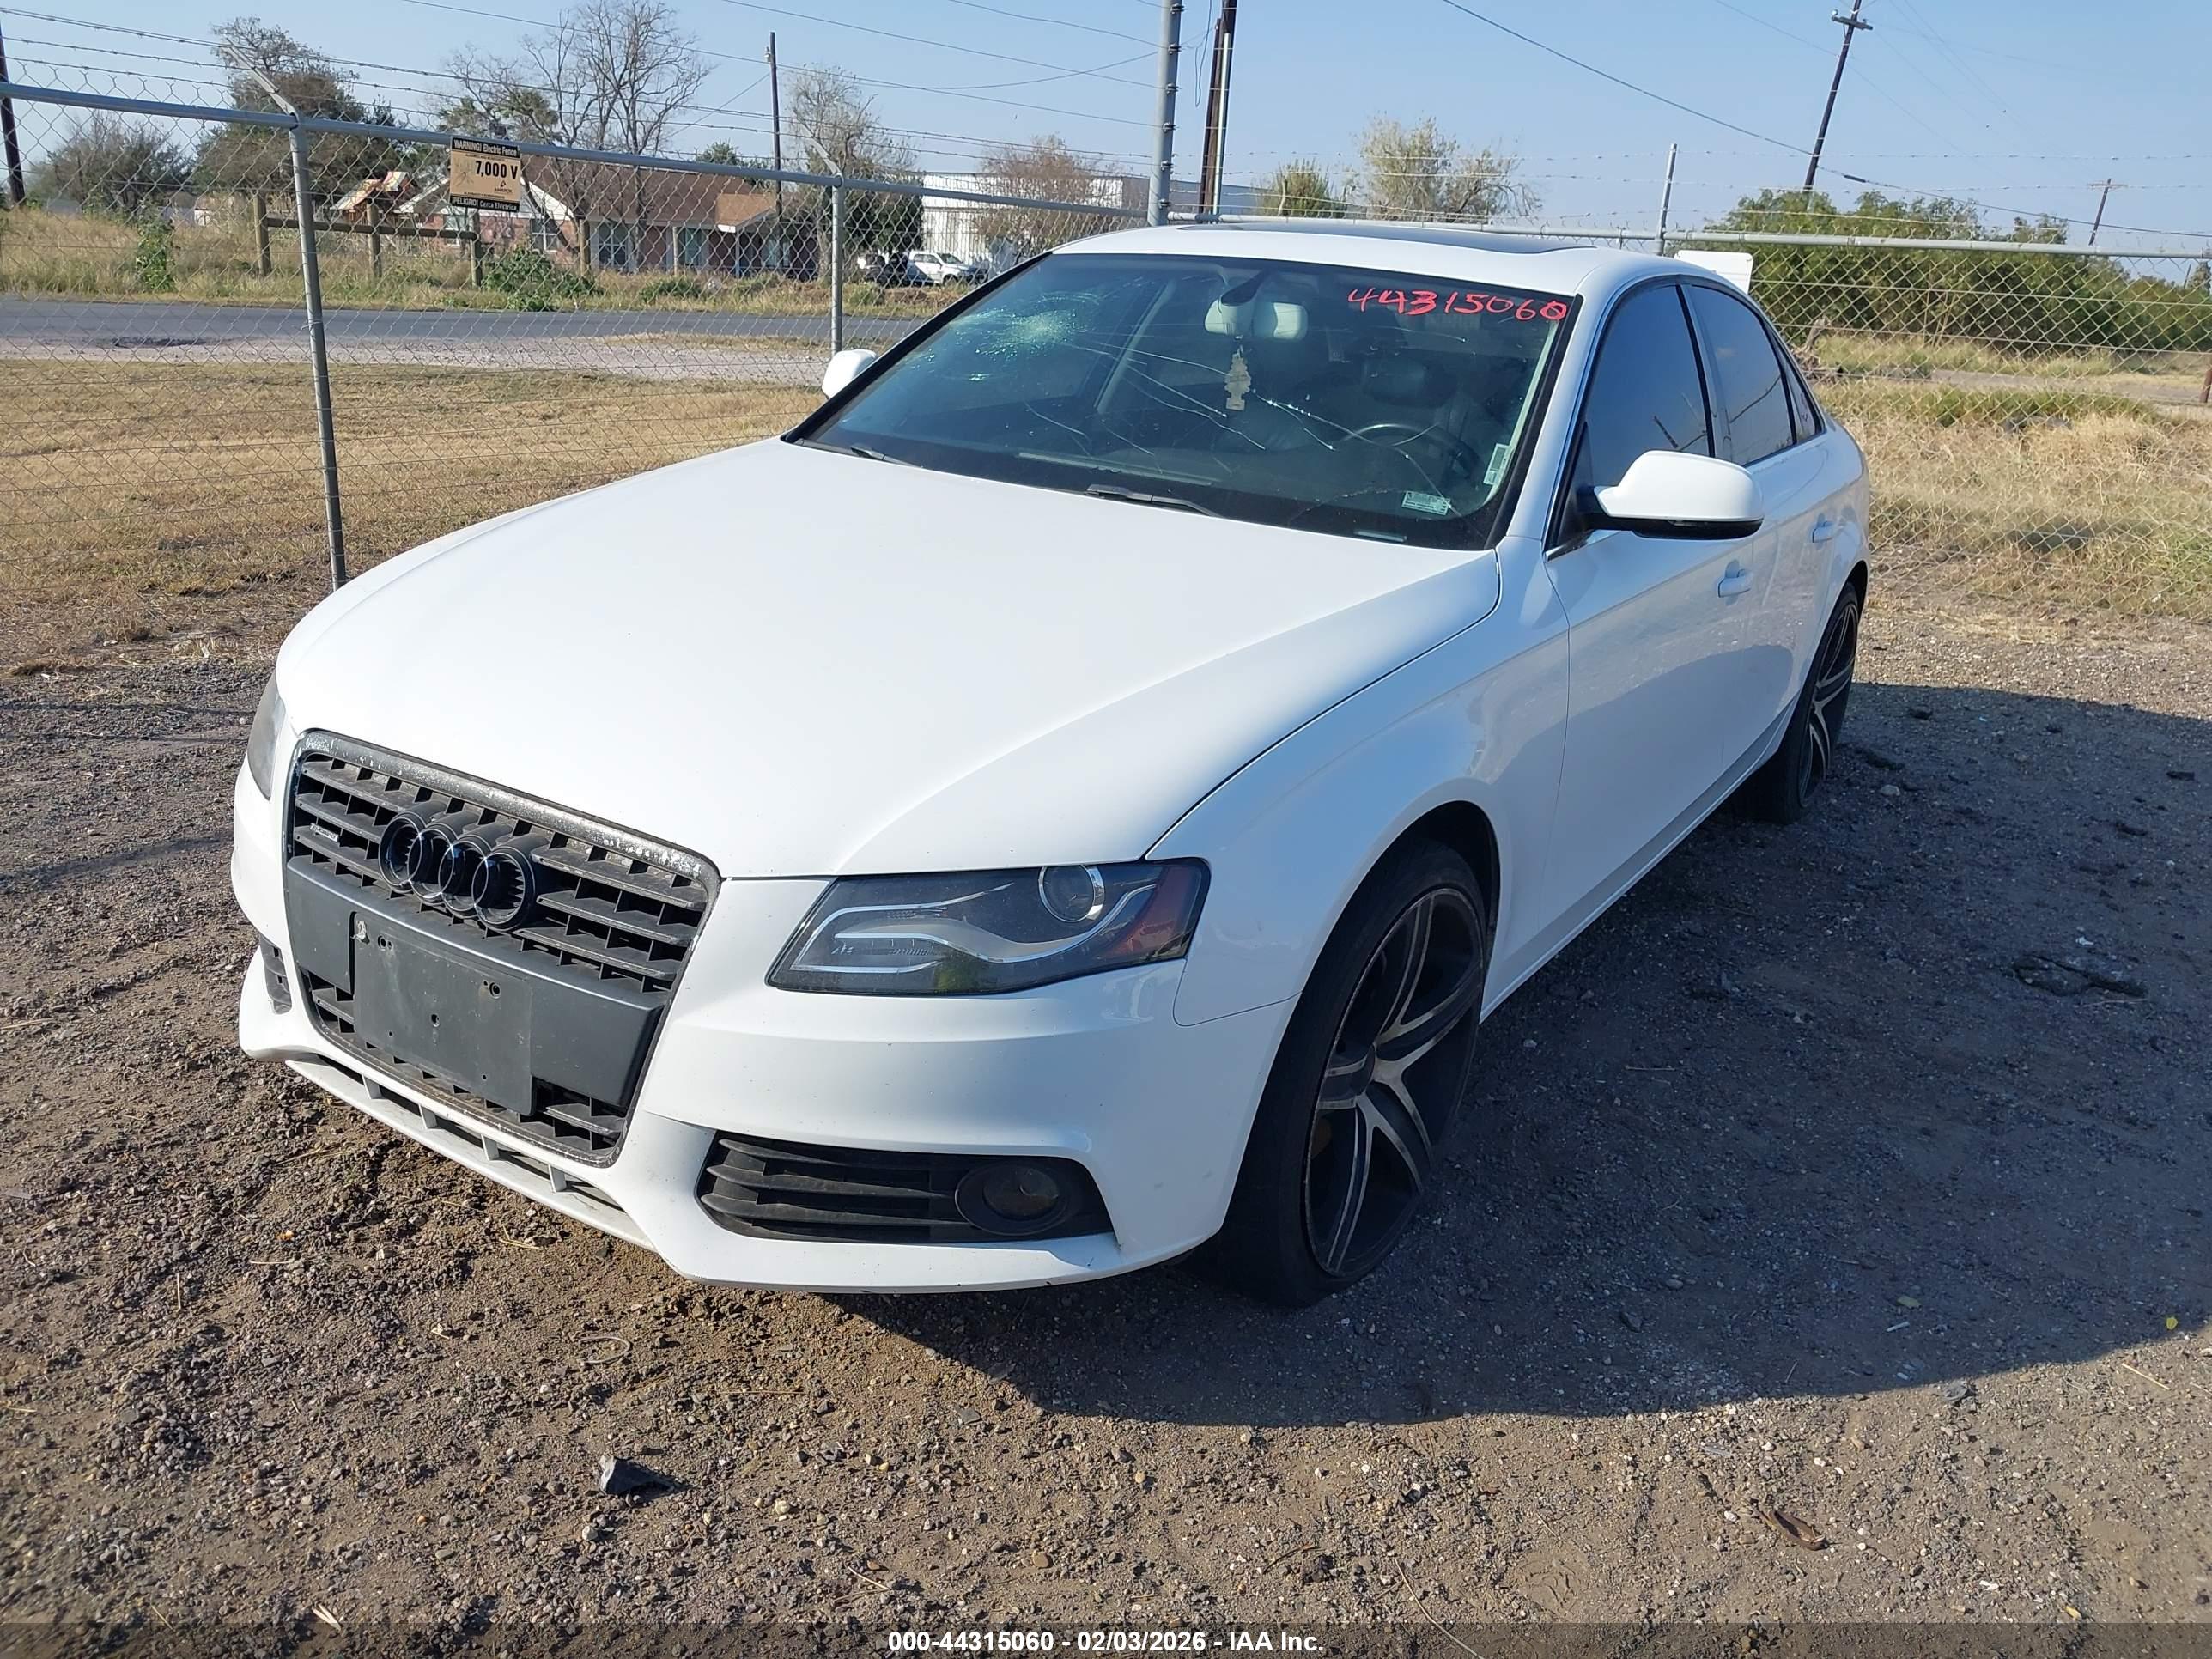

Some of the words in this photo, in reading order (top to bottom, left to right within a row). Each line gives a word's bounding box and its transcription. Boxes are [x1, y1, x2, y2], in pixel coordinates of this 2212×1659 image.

[453, 139, 482, 152] WARNING!
[483, 143, 501, 155] Electric
[501, 146, 517, 156] Fence
[475, 161, 507, 178] 7,000
[510, 165, 518, 179] V
[1347, 287, 1568, 321] 44315060
